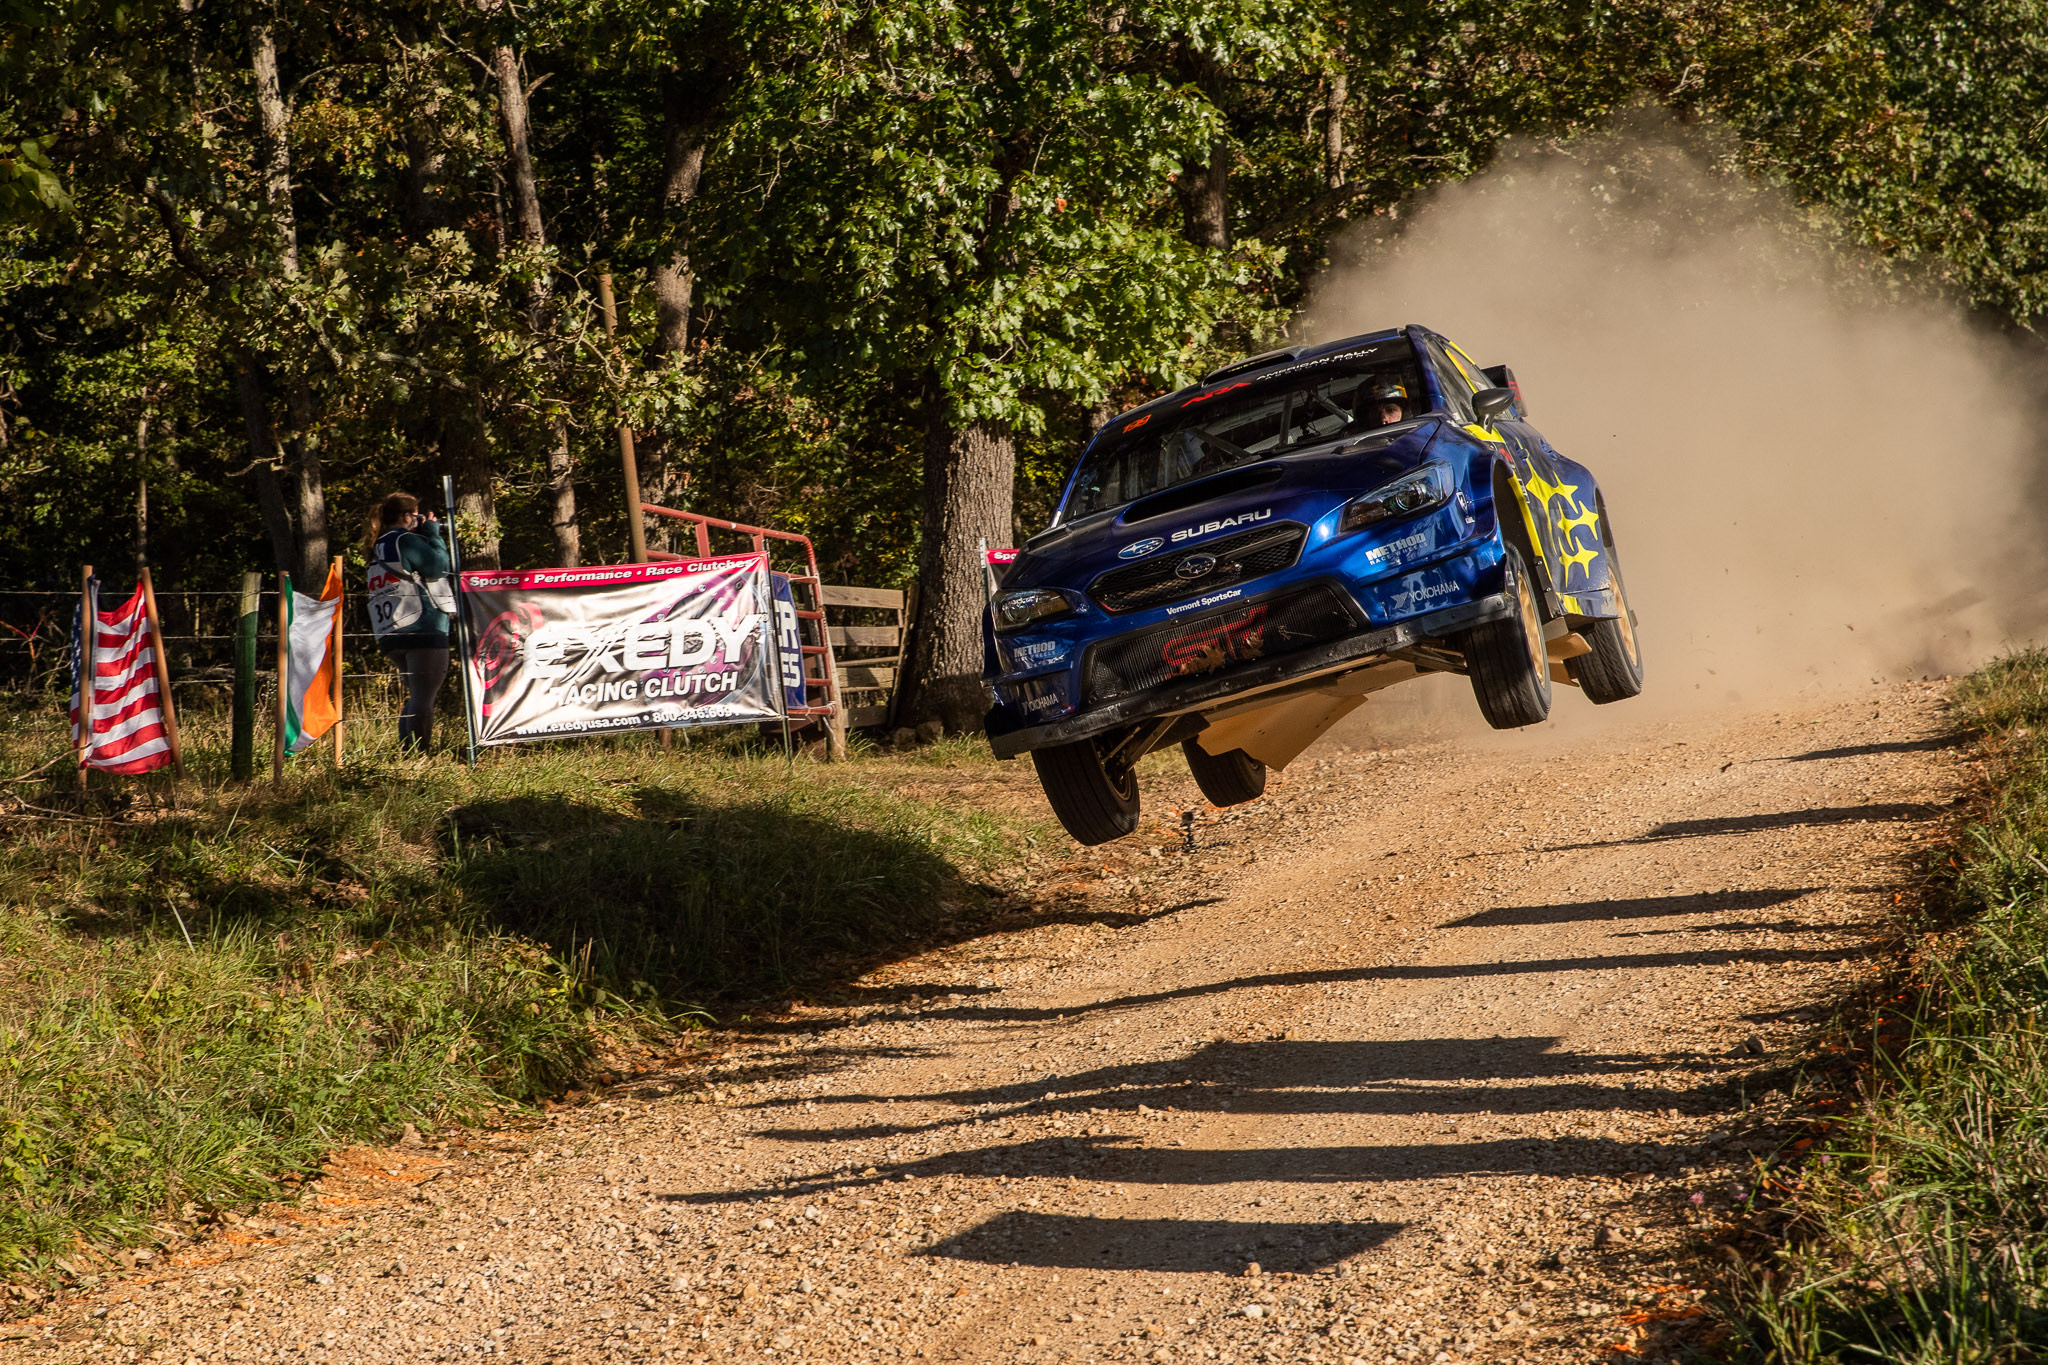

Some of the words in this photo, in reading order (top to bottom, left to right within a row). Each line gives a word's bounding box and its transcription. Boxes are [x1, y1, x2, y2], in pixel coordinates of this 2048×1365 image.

[1170, 508, 1272, 543] SUBARU
[994, 551, 1018, 561] Spo
[1365, 533, 1426, 561] METHOD
[469, 576, 520, 588] Sports
[533, 568, 633, 584] Performance
[645, 562, 683, 577] Race
[1166, 597, 1201, 615] Vermont
[1201, 589, 1242, 607] SportsCar
[1409, 580, 1460, 603] YOKOHAMA
[523, 613, 764, 684] EXEDY
[1013, 641, 1056, 658] METHOD
[643, 671, 739, 699] CLUTCH
[515, 715, 642, 735] www.exedyusa.com
